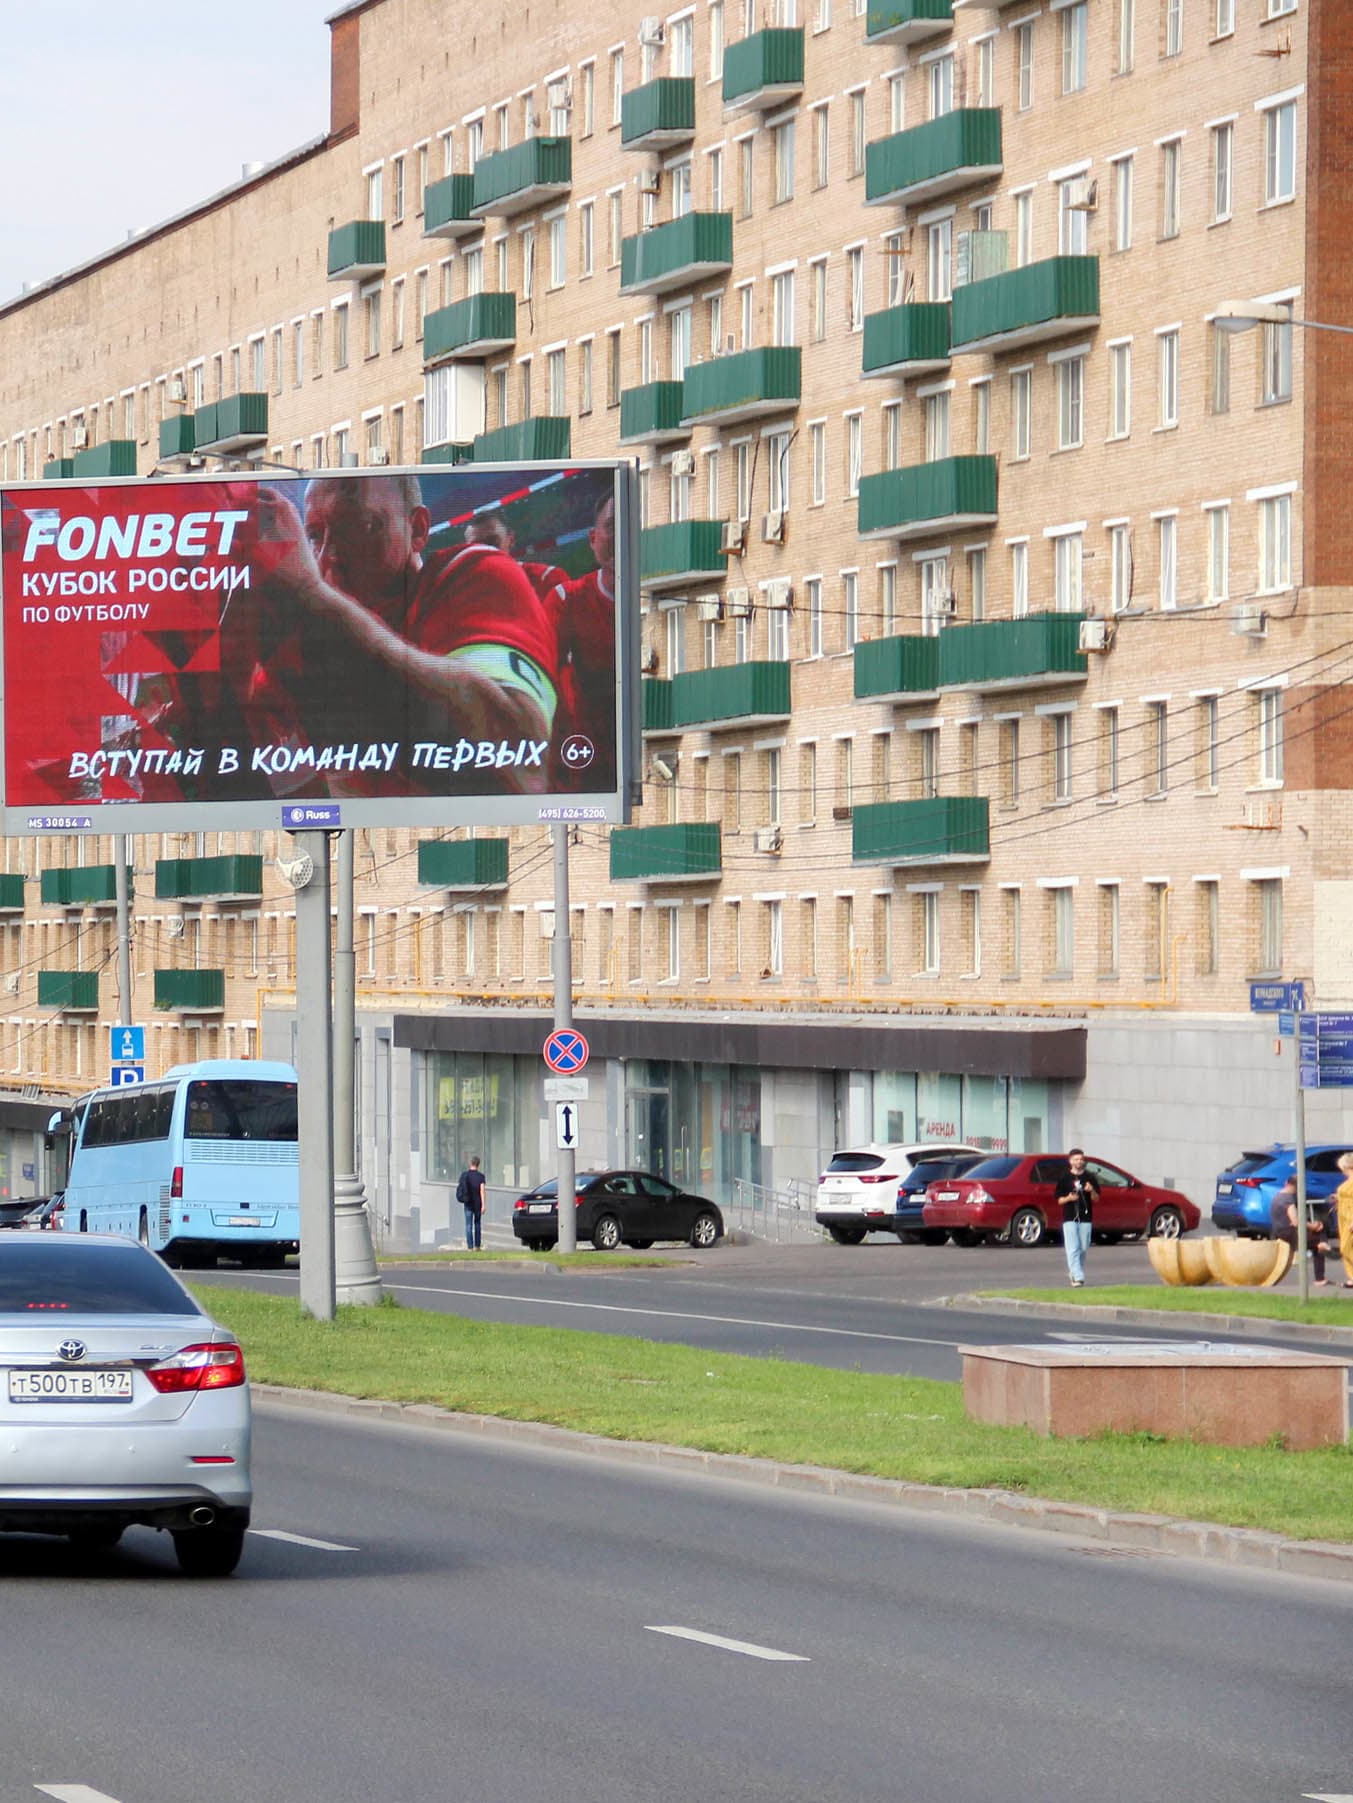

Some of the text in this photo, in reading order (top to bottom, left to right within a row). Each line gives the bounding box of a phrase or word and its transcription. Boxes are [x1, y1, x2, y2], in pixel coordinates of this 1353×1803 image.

[22, 510, 249, 562] FONBET
[22, 565, 250, 597] КУБОК РОССИИ
[22, 603, 150, 623] ПО ФУТБОЛУ
[68, 737, 548, 779] ВСТУПАЙ В КОМАНДУ ПЕРВЫХ
[566, 743, 592, 761] 6+
[305, 810, 331, 820] Russ
[538, 808, 561, 819] (495)
[28, 818, 43, 828] MS
[46, 817, 78, 828] 30054
[926, 1121, 956, 1138] АРЕНДА
[97, 1373, 126, 1388] 197
